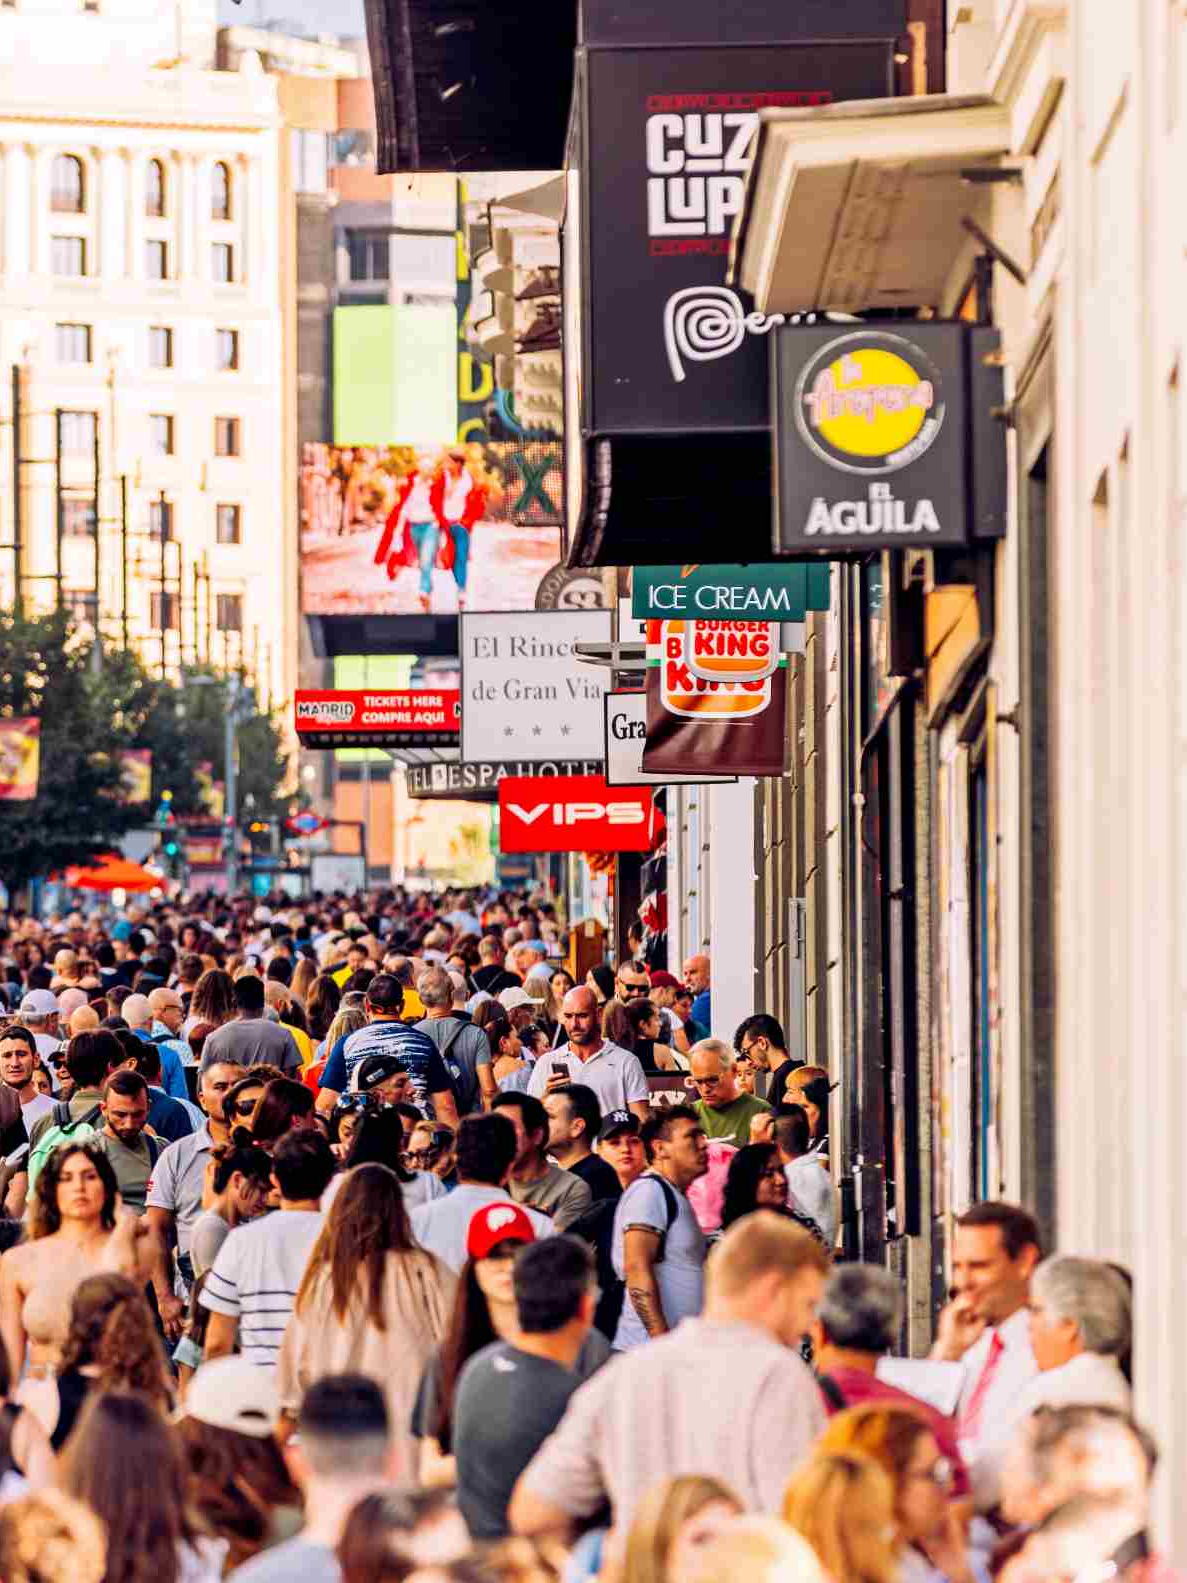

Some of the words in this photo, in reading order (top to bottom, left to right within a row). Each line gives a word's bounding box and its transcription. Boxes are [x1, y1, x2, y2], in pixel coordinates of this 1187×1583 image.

[869, 482, 895, 500] EL
[648, 585, 687, 610] ICE
[695, 586, 791, 611] CREAM
[695, 620, 771, 633] BURGER
[472, 636, 500, 659] El
[694, 632, 771, 657] KING
[471, 679, 498, 701] de
[503, 678, 558, 701] Gran
[298, 702, 355, 718] MADRID
[364, 696, 410, 708] TICKETS
[414, 696, 443, 708] HERE
[361, 711, 412, 723] COMPRE
[611, 713, 646, 740] Gra
[506, 802, 645, 825] VIPS
